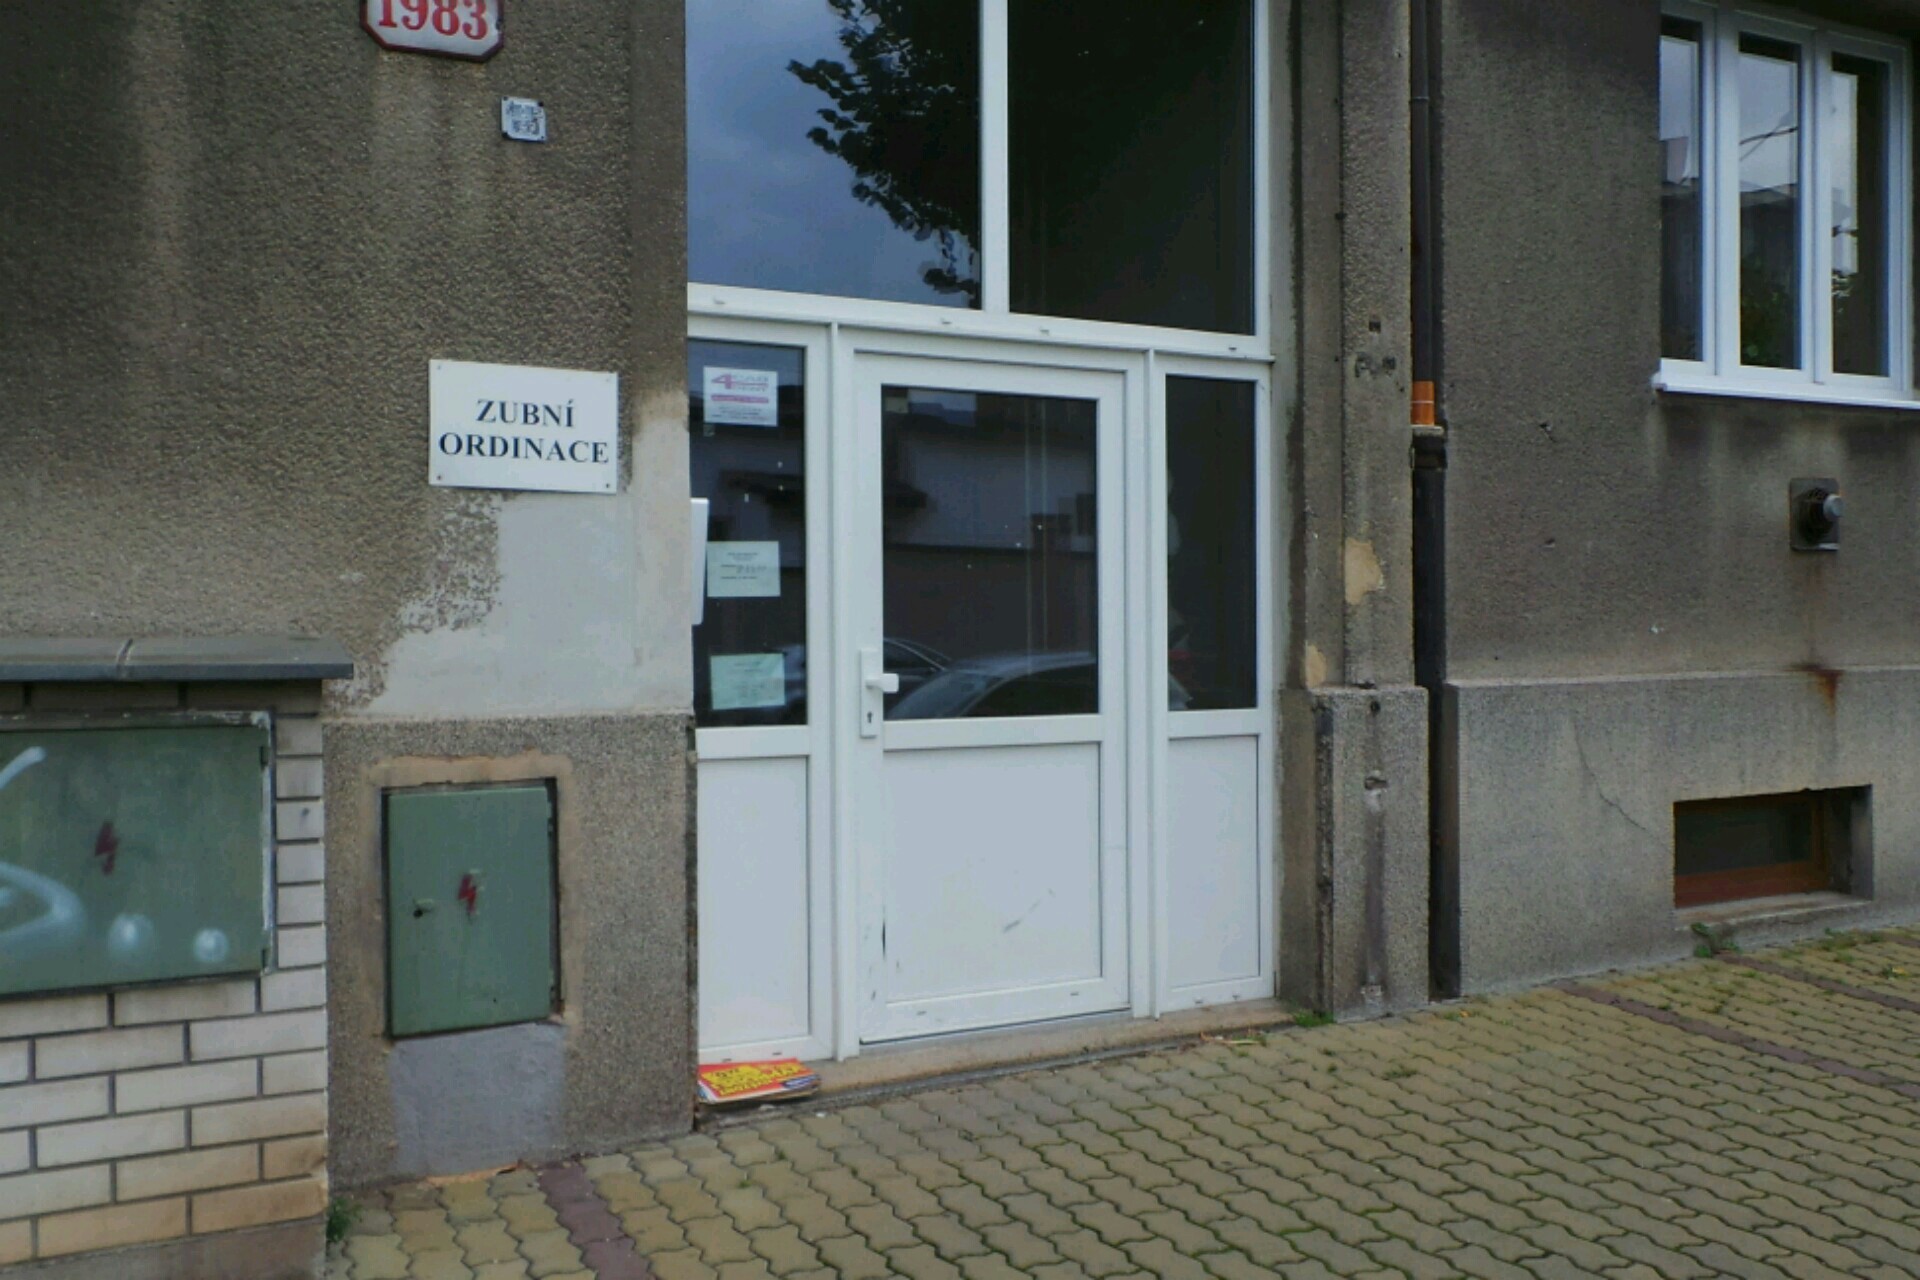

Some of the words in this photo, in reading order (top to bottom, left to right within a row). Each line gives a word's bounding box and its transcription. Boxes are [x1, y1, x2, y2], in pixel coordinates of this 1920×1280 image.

[378, 0, 488, 40] 1983
[476, 399, 575, 428] ZUBNÍ
[438, 432, 609, 464] ORDINACE
